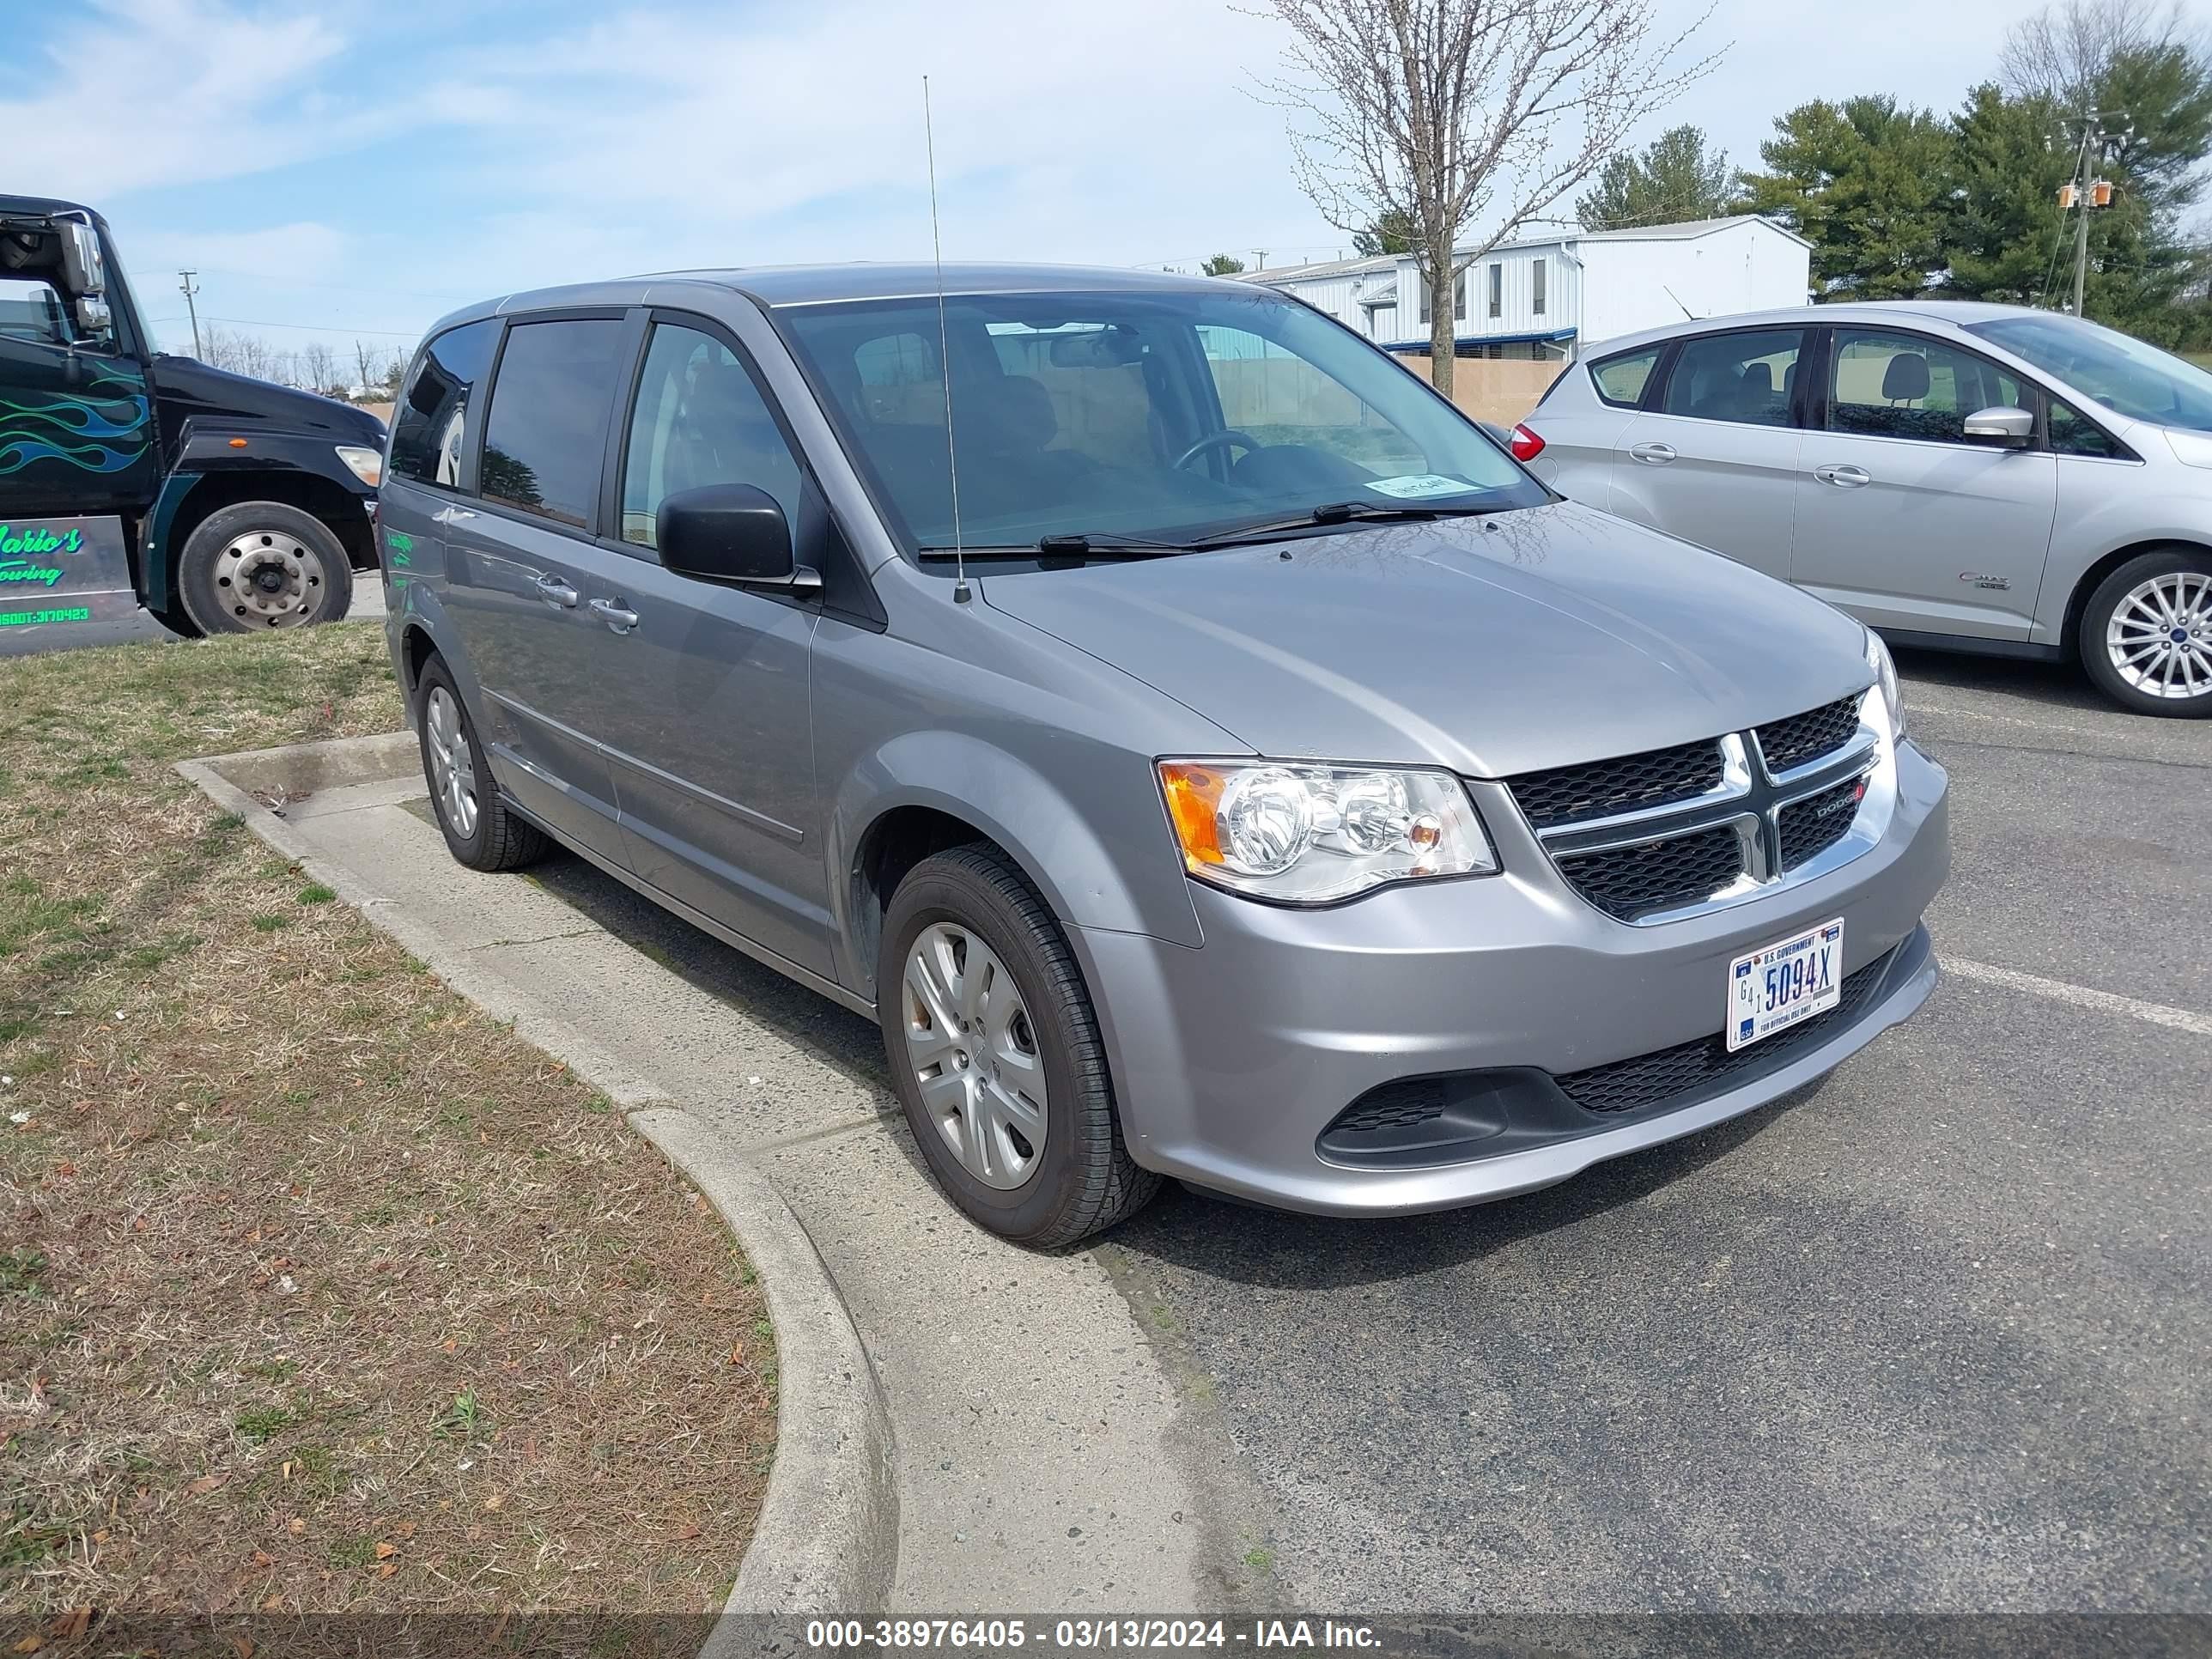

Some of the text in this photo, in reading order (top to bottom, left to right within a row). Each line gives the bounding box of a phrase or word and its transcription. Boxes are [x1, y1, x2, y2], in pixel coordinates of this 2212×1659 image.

[0, 607, 88, 626] SDOT:3170423
[1764, 951, 1776, 965] U.S.
[1777, 935, 1815, 960] GOVERNMENT
[1765, 945, 1831, 1012] 5094X
[1760, 1022, 1770, 1033] FOR
[1770, 1013, 1790, 1030] OFFICIAL
[1800, 1004, 1812, 1015] ONLY
